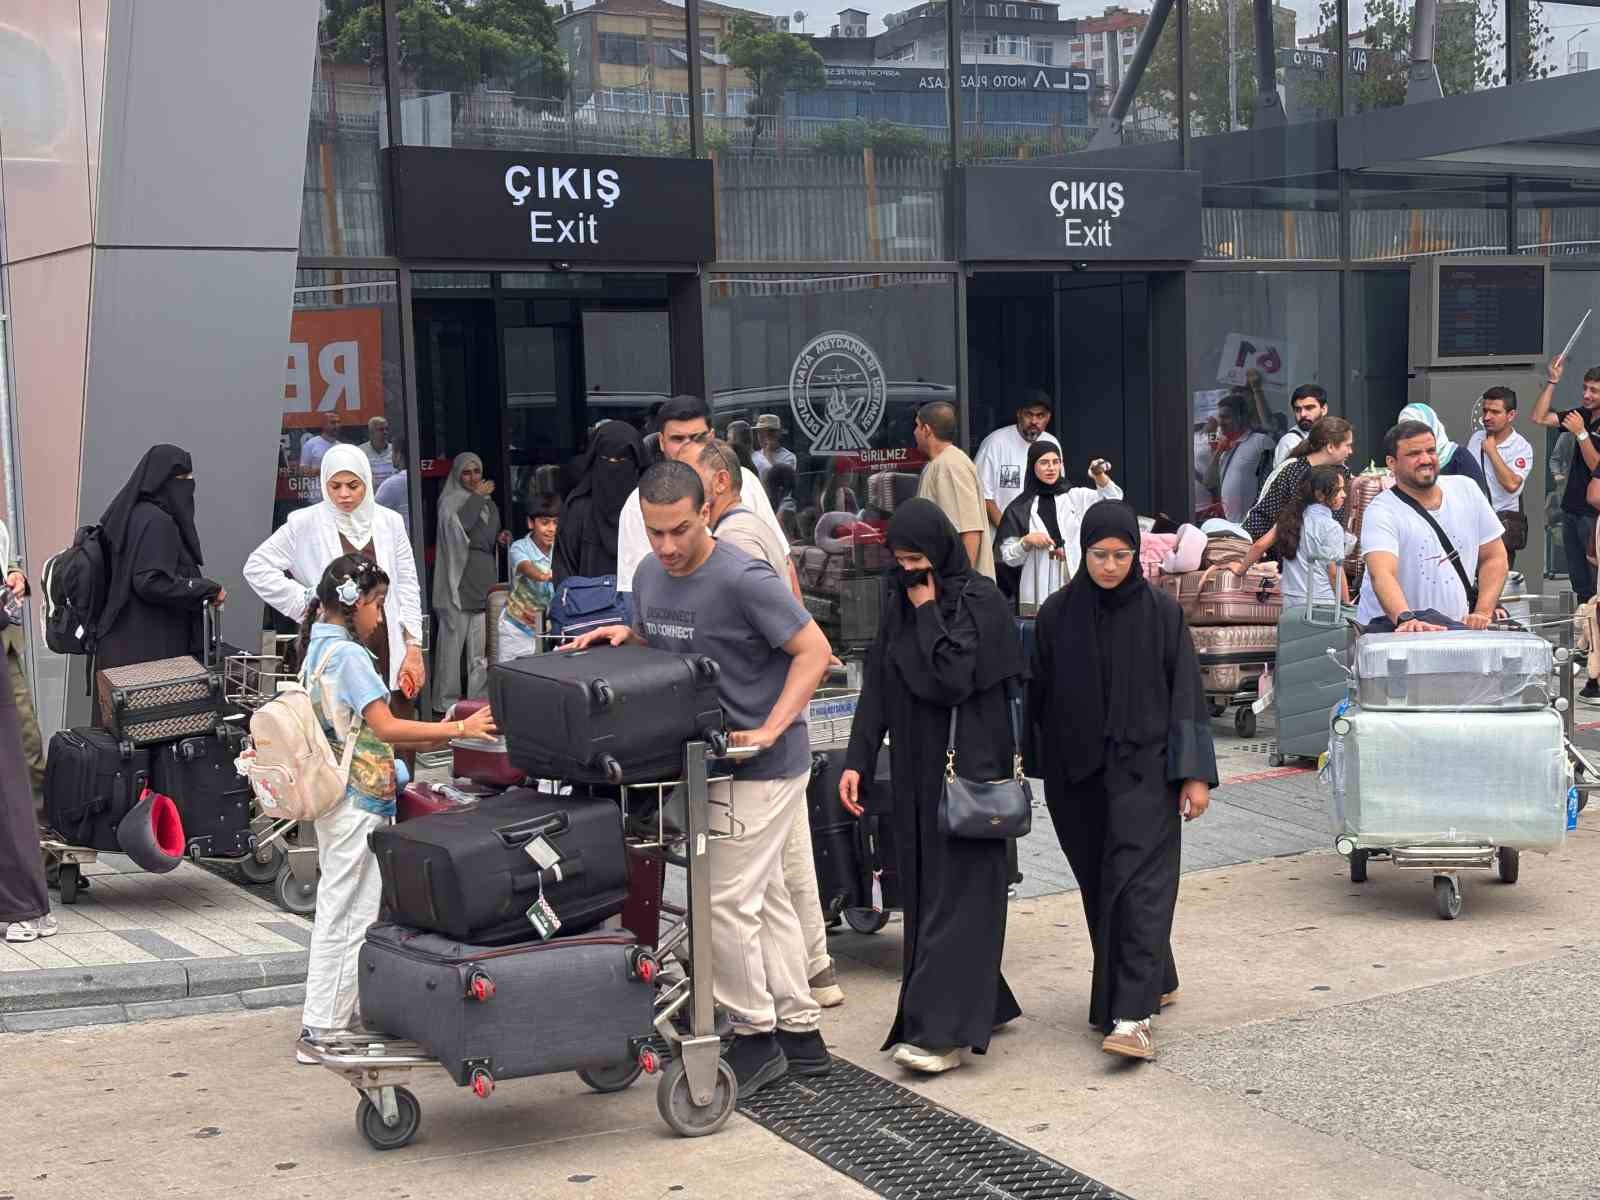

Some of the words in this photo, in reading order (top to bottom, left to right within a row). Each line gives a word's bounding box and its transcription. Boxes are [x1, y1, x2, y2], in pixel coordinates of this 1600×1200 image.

[505, 165, 621, 209] ÇIKIŞ
[1049, 180, 1125, 218] ÇIKIŞ
[530, 210, 599, 244] Exit
[1064, 218, 1113, 247] Exit
[796, 353, 815, 388] HAVA
[646, 622, 657, 634] TO
